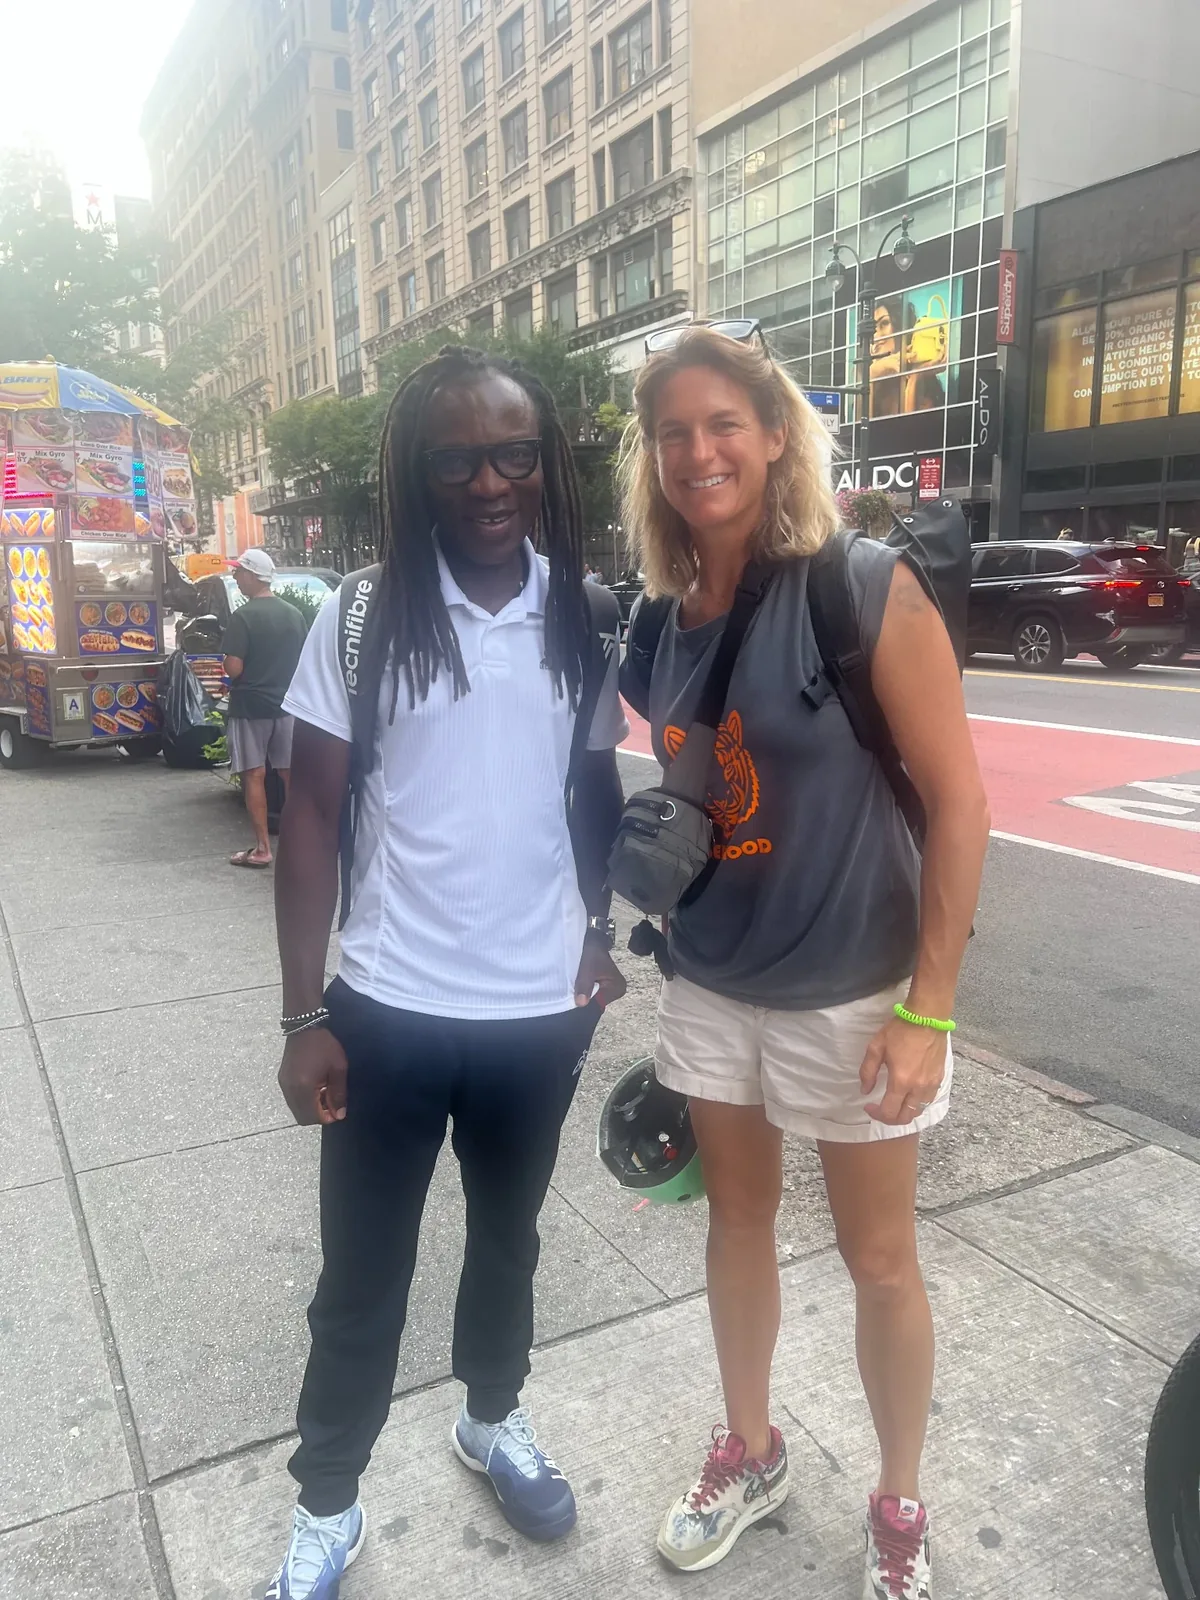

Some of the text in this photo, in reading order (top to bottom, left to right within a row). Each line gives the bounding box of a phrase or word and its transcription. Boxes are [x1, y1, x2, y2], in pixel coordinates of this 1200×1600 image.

[1000, 268, 1015, 335] Superdry
[1134, 309, 1163, 323] PURE
[1117, 330, 1166, 349] ORGANIC
[1139, 340, 1174, 356] HELPS
[1103, 369, 1138, 384] EDUCE
[1140, 364, 1164, 378] OUR
[1150, 375, 1166, 387] BY
[979, 378, 990, 446] ALDO
[49, 450, 66, 459] Gyro
[89, 452, 104, 460] Mix
[104, 454, 123, 463] Gyro
[80, 530, 103, 538] Chicken
[68, 698, 79, 711] A
